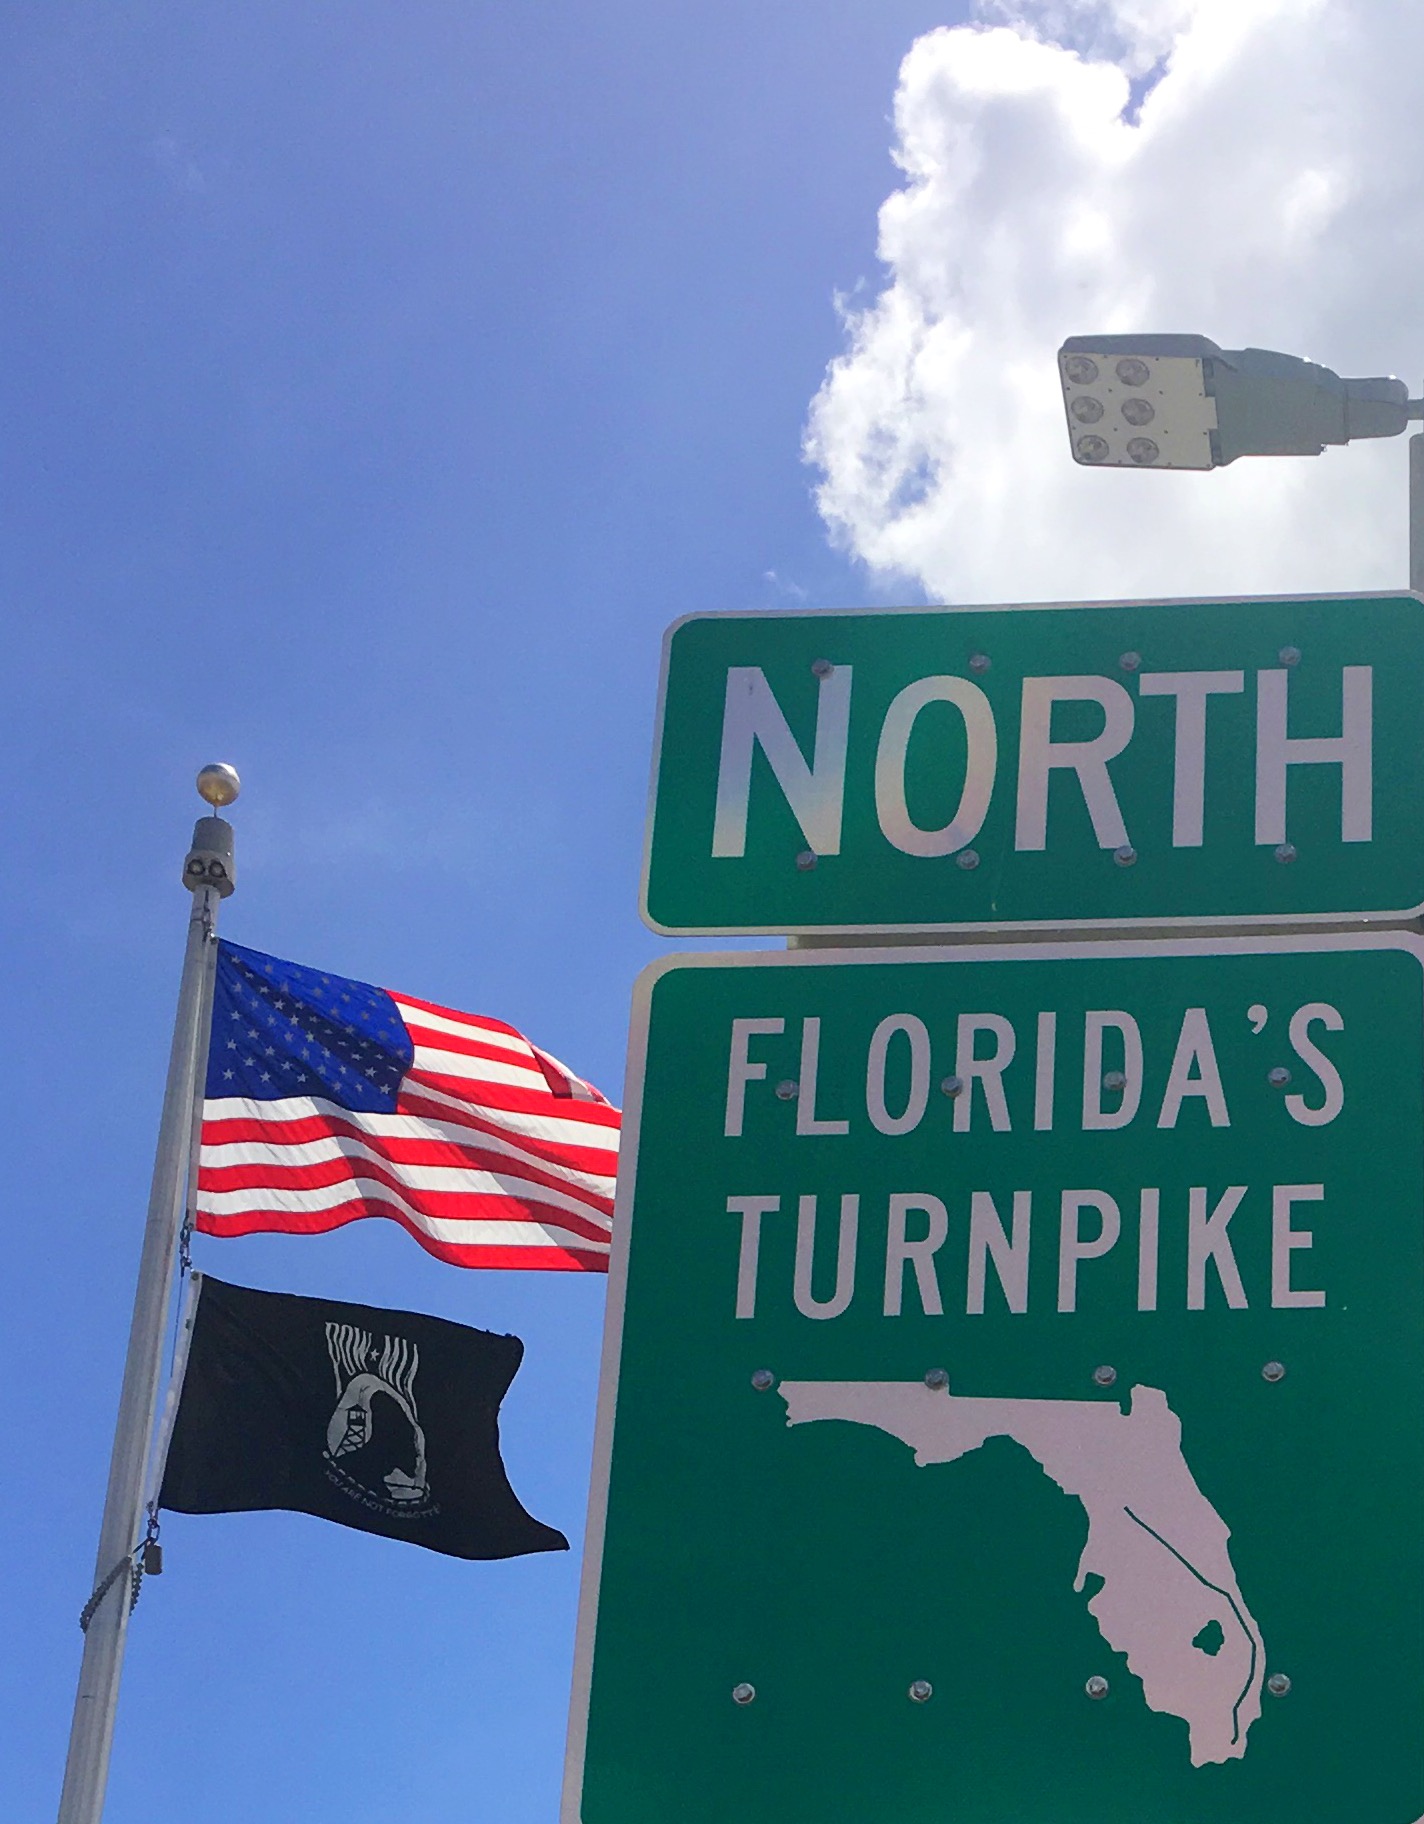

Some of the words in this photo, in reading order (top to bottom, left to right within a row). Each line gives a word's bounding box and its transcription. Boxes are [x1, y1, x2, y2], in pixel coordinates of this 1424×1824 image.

[711, 664, 1374, 858] NORTH
[724, 1002, 1345, 1138] FLORIDA'S
[726, 1183, 1327, 1320] TURNPIKE
[325, 1321, 372, 1400] POW
[361, 1497, 384, 1513] NOT
